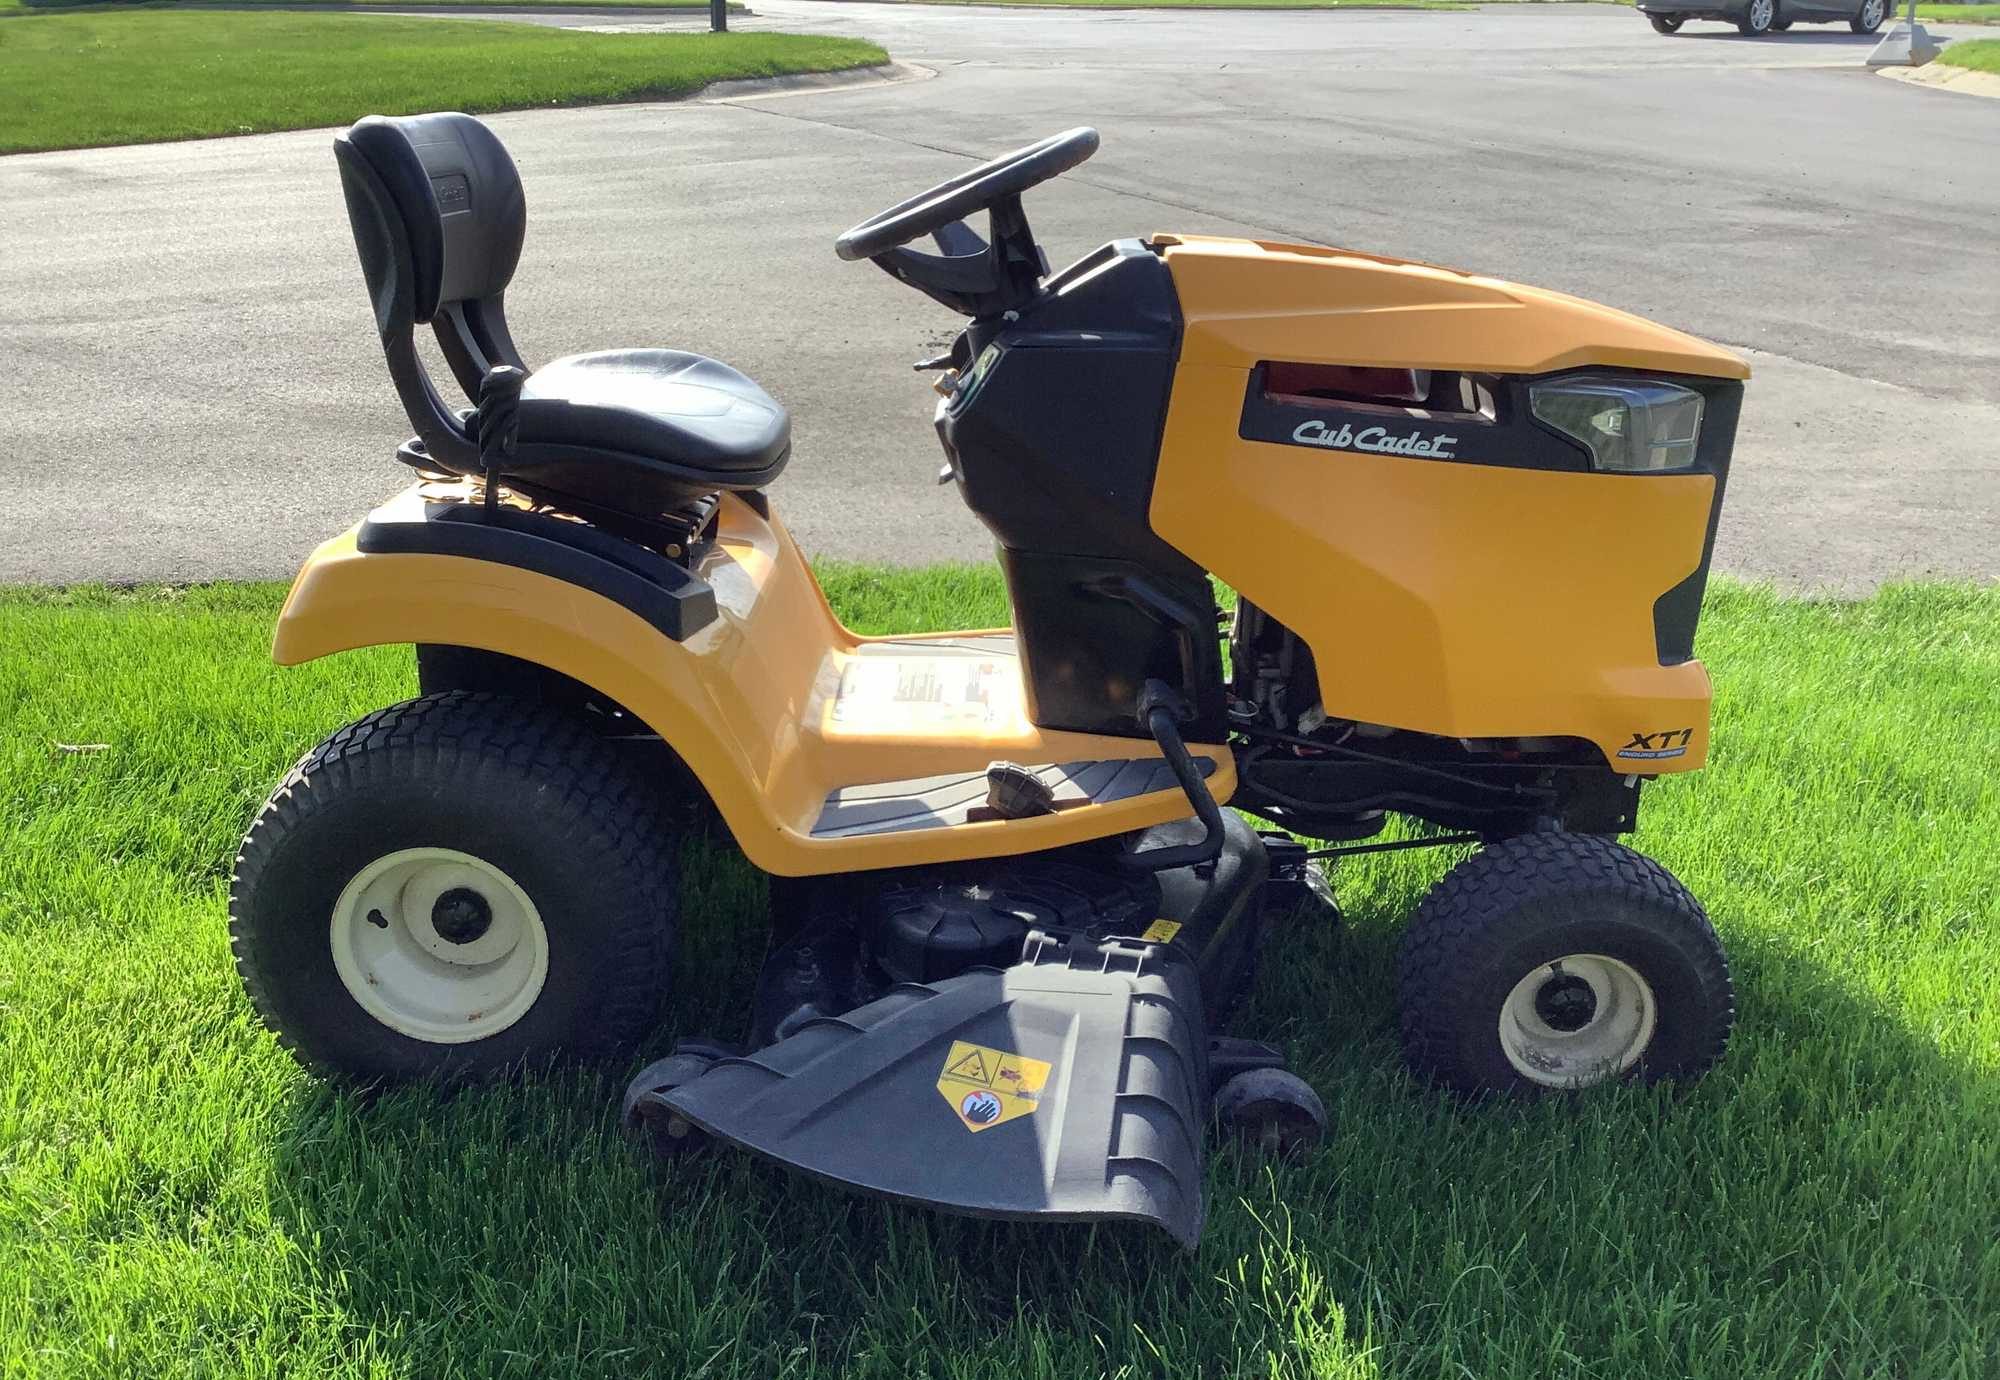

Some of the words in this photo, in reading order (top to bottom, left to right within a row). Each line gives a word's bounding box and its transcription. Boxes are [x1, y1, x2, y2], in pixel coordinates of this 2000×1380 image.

[1293, 420, 1353, 448] Cub
[1353, 427, 1458, 458] Cadet
[1622, 727, 1694, 750] XT1
